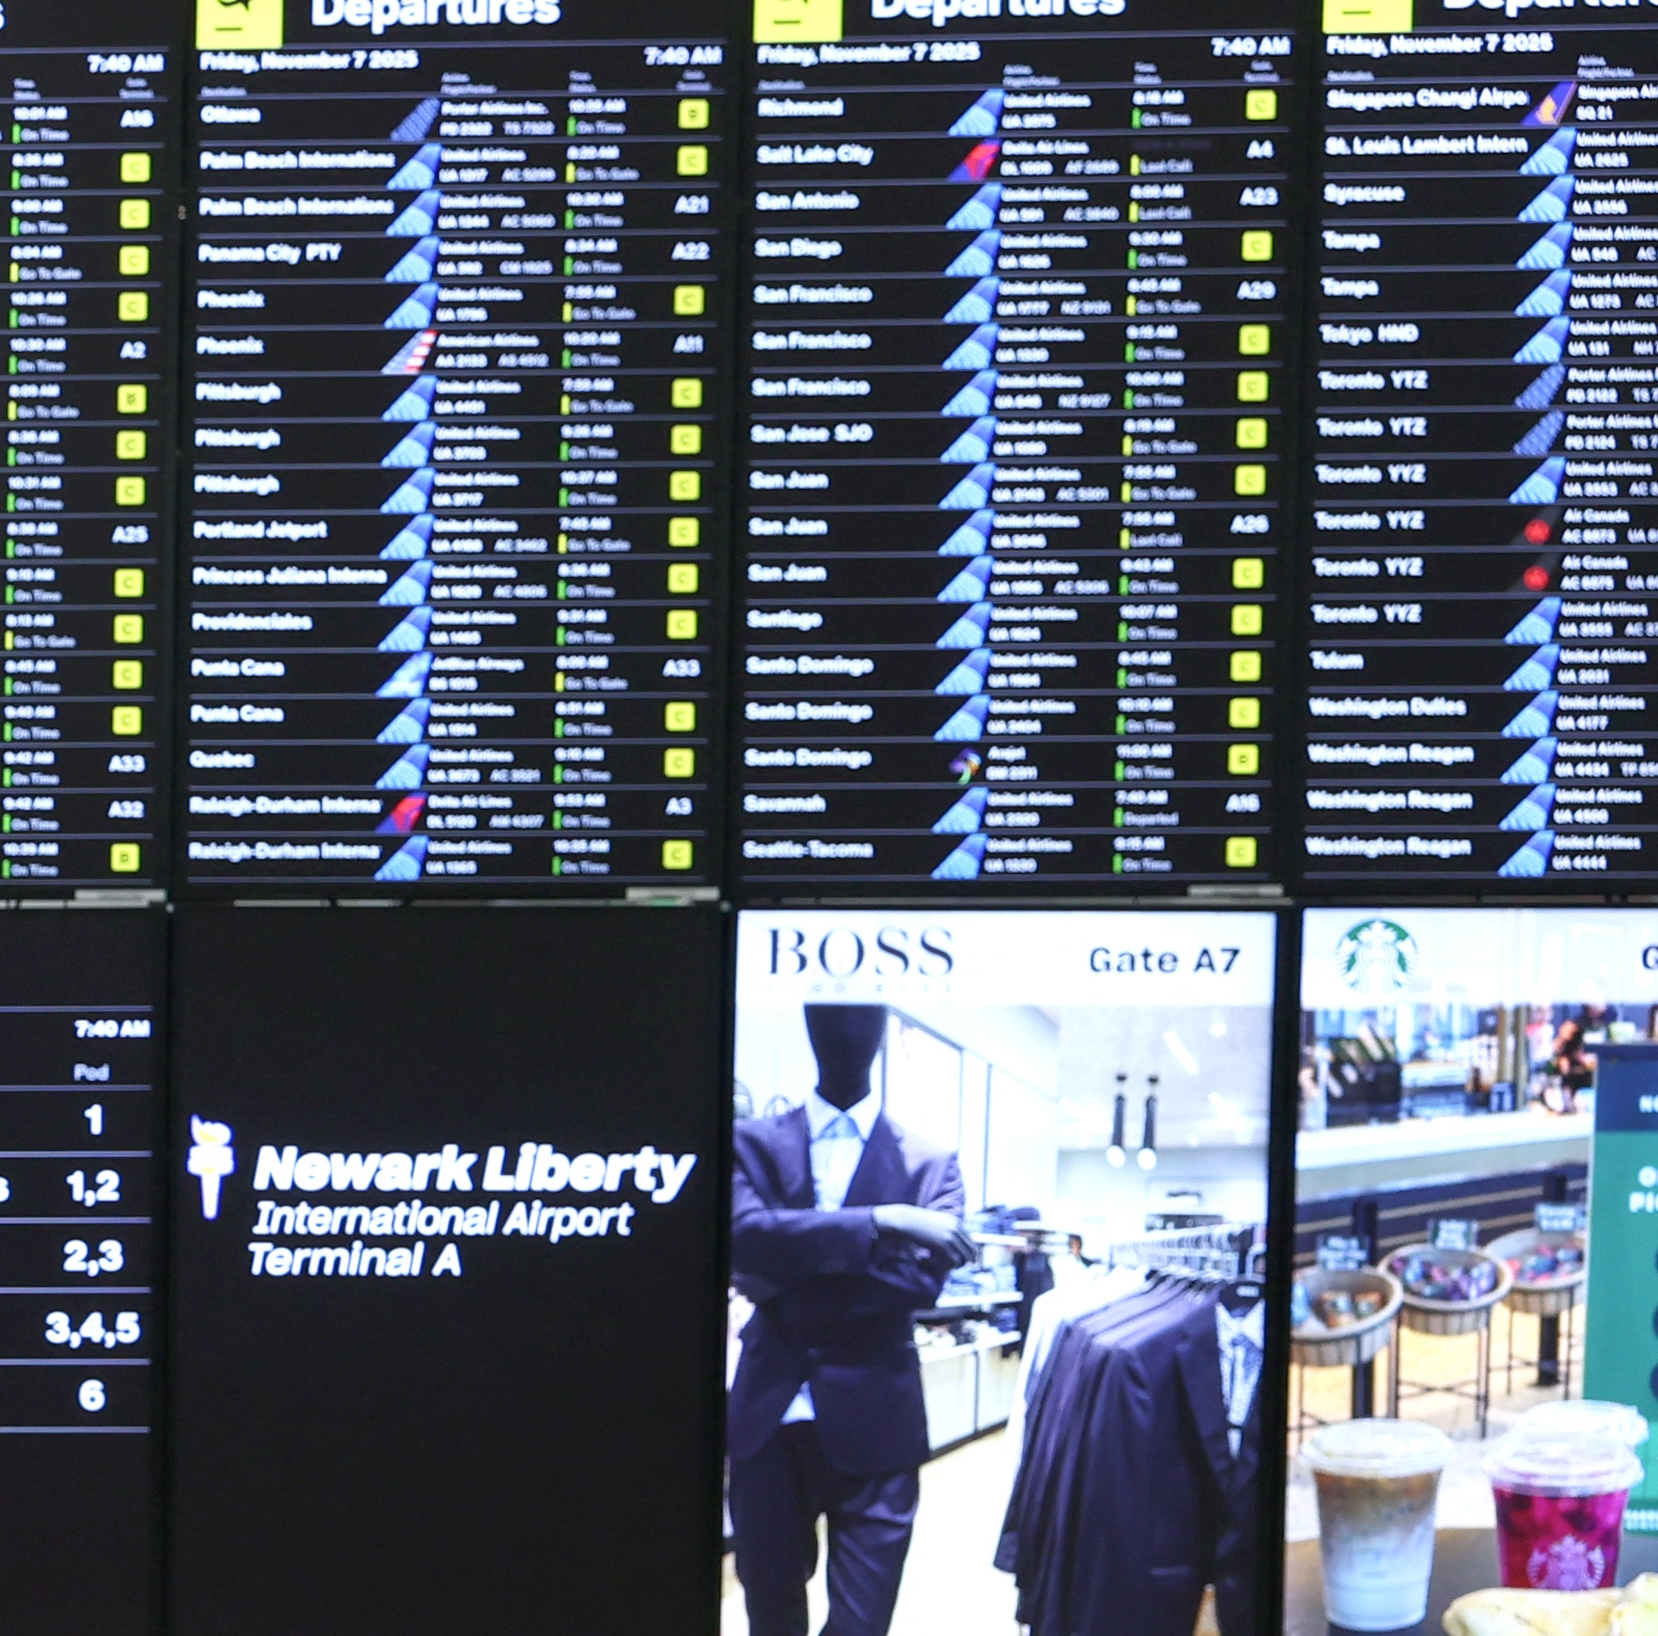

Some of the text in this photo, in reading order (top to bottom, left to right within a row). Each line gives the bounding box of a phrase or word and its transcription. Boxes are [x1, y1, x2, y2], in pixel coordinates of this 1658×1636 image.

[312, 0, 560, 34] Departures
[88, 54, 163, 72] 7:40 AM
[672, 242, 709, 260] A22
[1322, 231, 1380, 251] Tampa
[750, 471, 828, 489] San Juan
[1315, 464, 1425, 483] Toronto YYZ
[112, 526, 148, 543] A25
[192, 659, 284, 676] Punta Cana
[769, 929, 953, 974] BOSS
[1091, 949, 1239, 972] Gate A7
[75, 1020, 150, 1037] 7:40 AM
[74, 1064, 109, 1081] Pod
[85, 1104, 102, 1134] 1
[253, 1142, 696, 1201] Newark Liberty
[67, 1170, 119, 1206] 1,2
[252, 1199, 634, 1243] International Airport
[64, 1240, 123, 1276] 2,3
[248, 1240, 461, 1276] Terminal A
[45, 1312, 140, 1348] 3,4,5
[79, 1380, 105, 1411] 6
